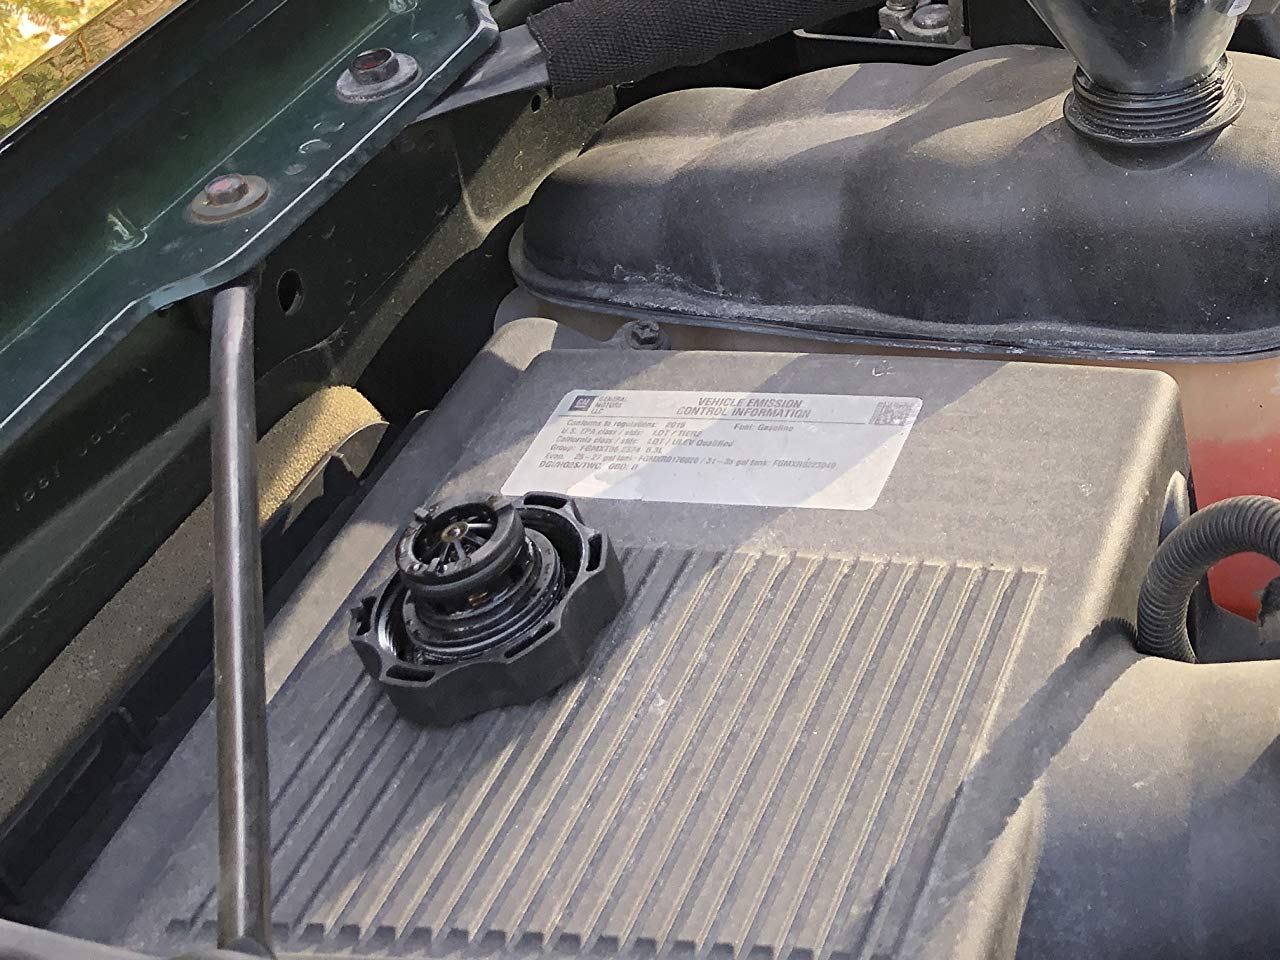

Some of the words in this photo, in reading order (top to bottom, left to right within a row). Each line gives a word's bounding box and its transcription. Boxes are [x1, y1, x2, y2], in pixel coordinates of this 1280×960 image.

[594, 401, 623, 409] MOTORS
[698, 397, 743, 407] VEHICLE
[746, 398, 803, 409] EMISSION
[676, 406, 727, 416] CONTROL
[731, 407, 812, 419] INFORMATION
[757, 423, 794, 432] Gasoline
